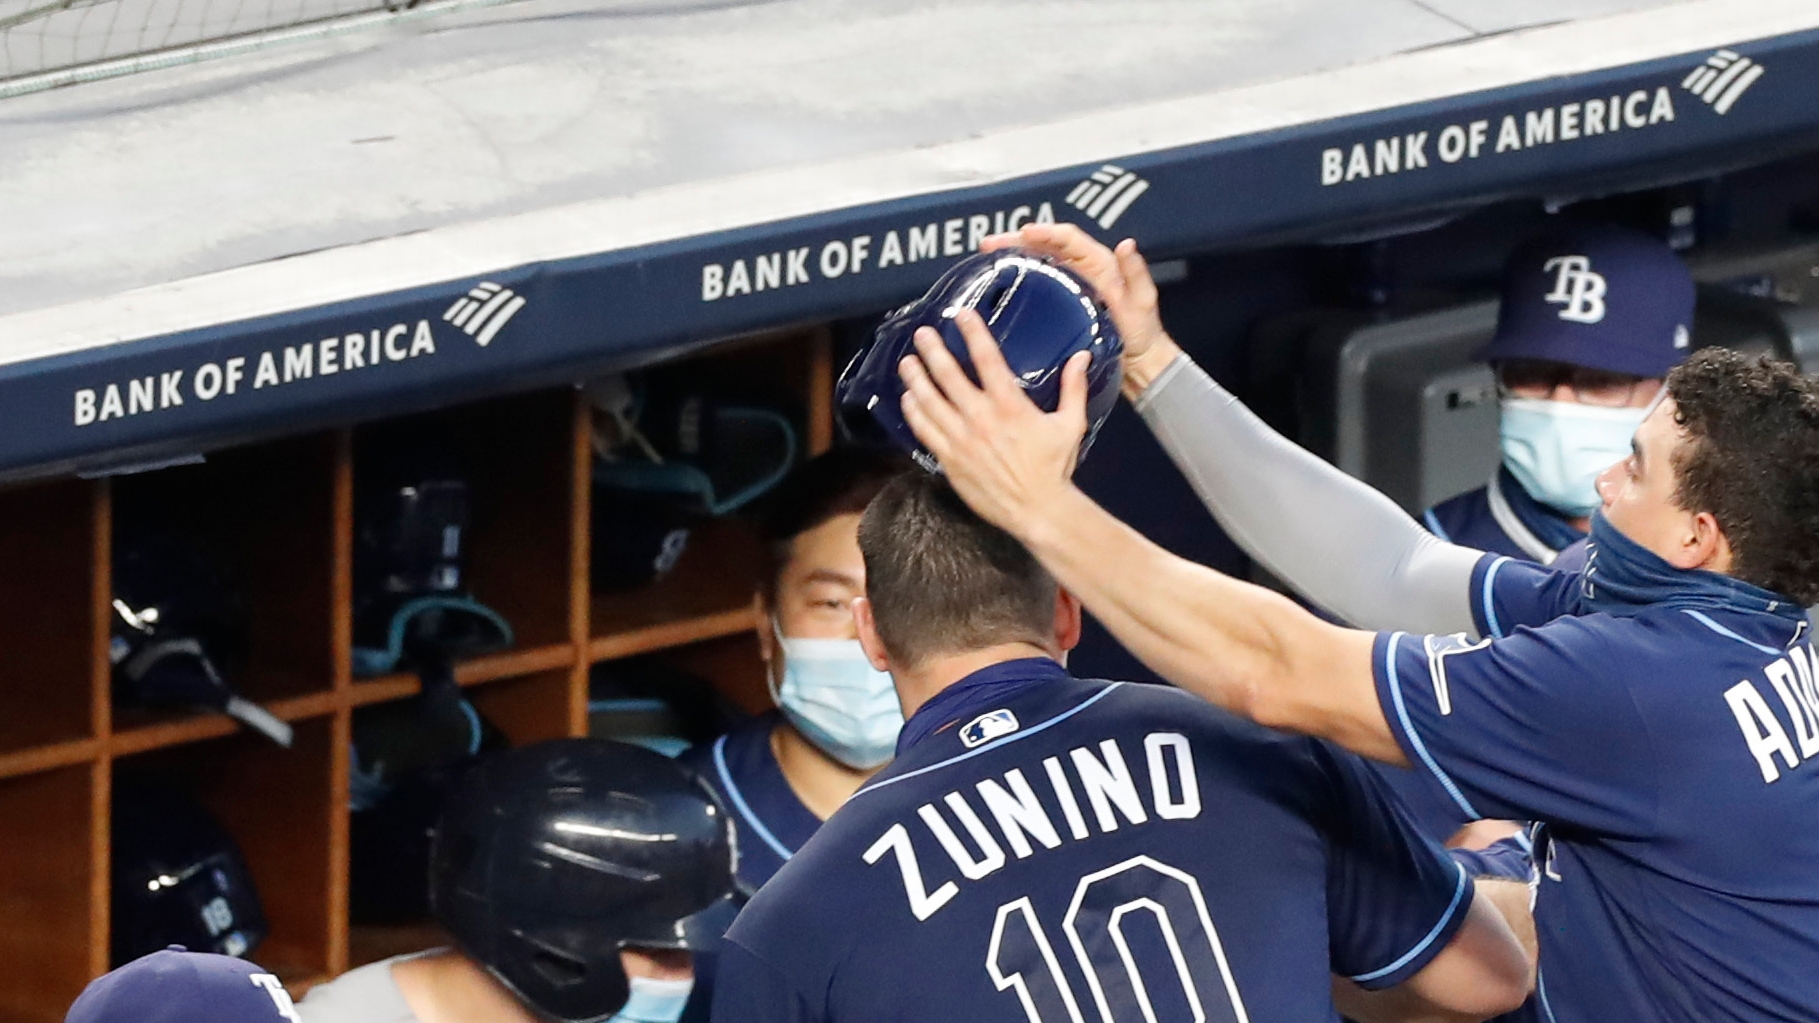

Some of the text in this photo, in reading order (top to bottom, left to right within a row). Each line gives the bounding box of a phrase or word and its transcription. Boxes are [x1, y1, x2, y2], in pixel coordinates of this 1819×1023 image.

[1322, 87, 1674, 185] BANK OF AMERICA
[702, 247, 809, 301] BANK
[820, 236, 871, 278] OF
[1542, 254, 1608, 325] TB
[75, 320, 435, 426] BANK OF AMERICA
[862, 732, 1201, 921] ZUNINO
